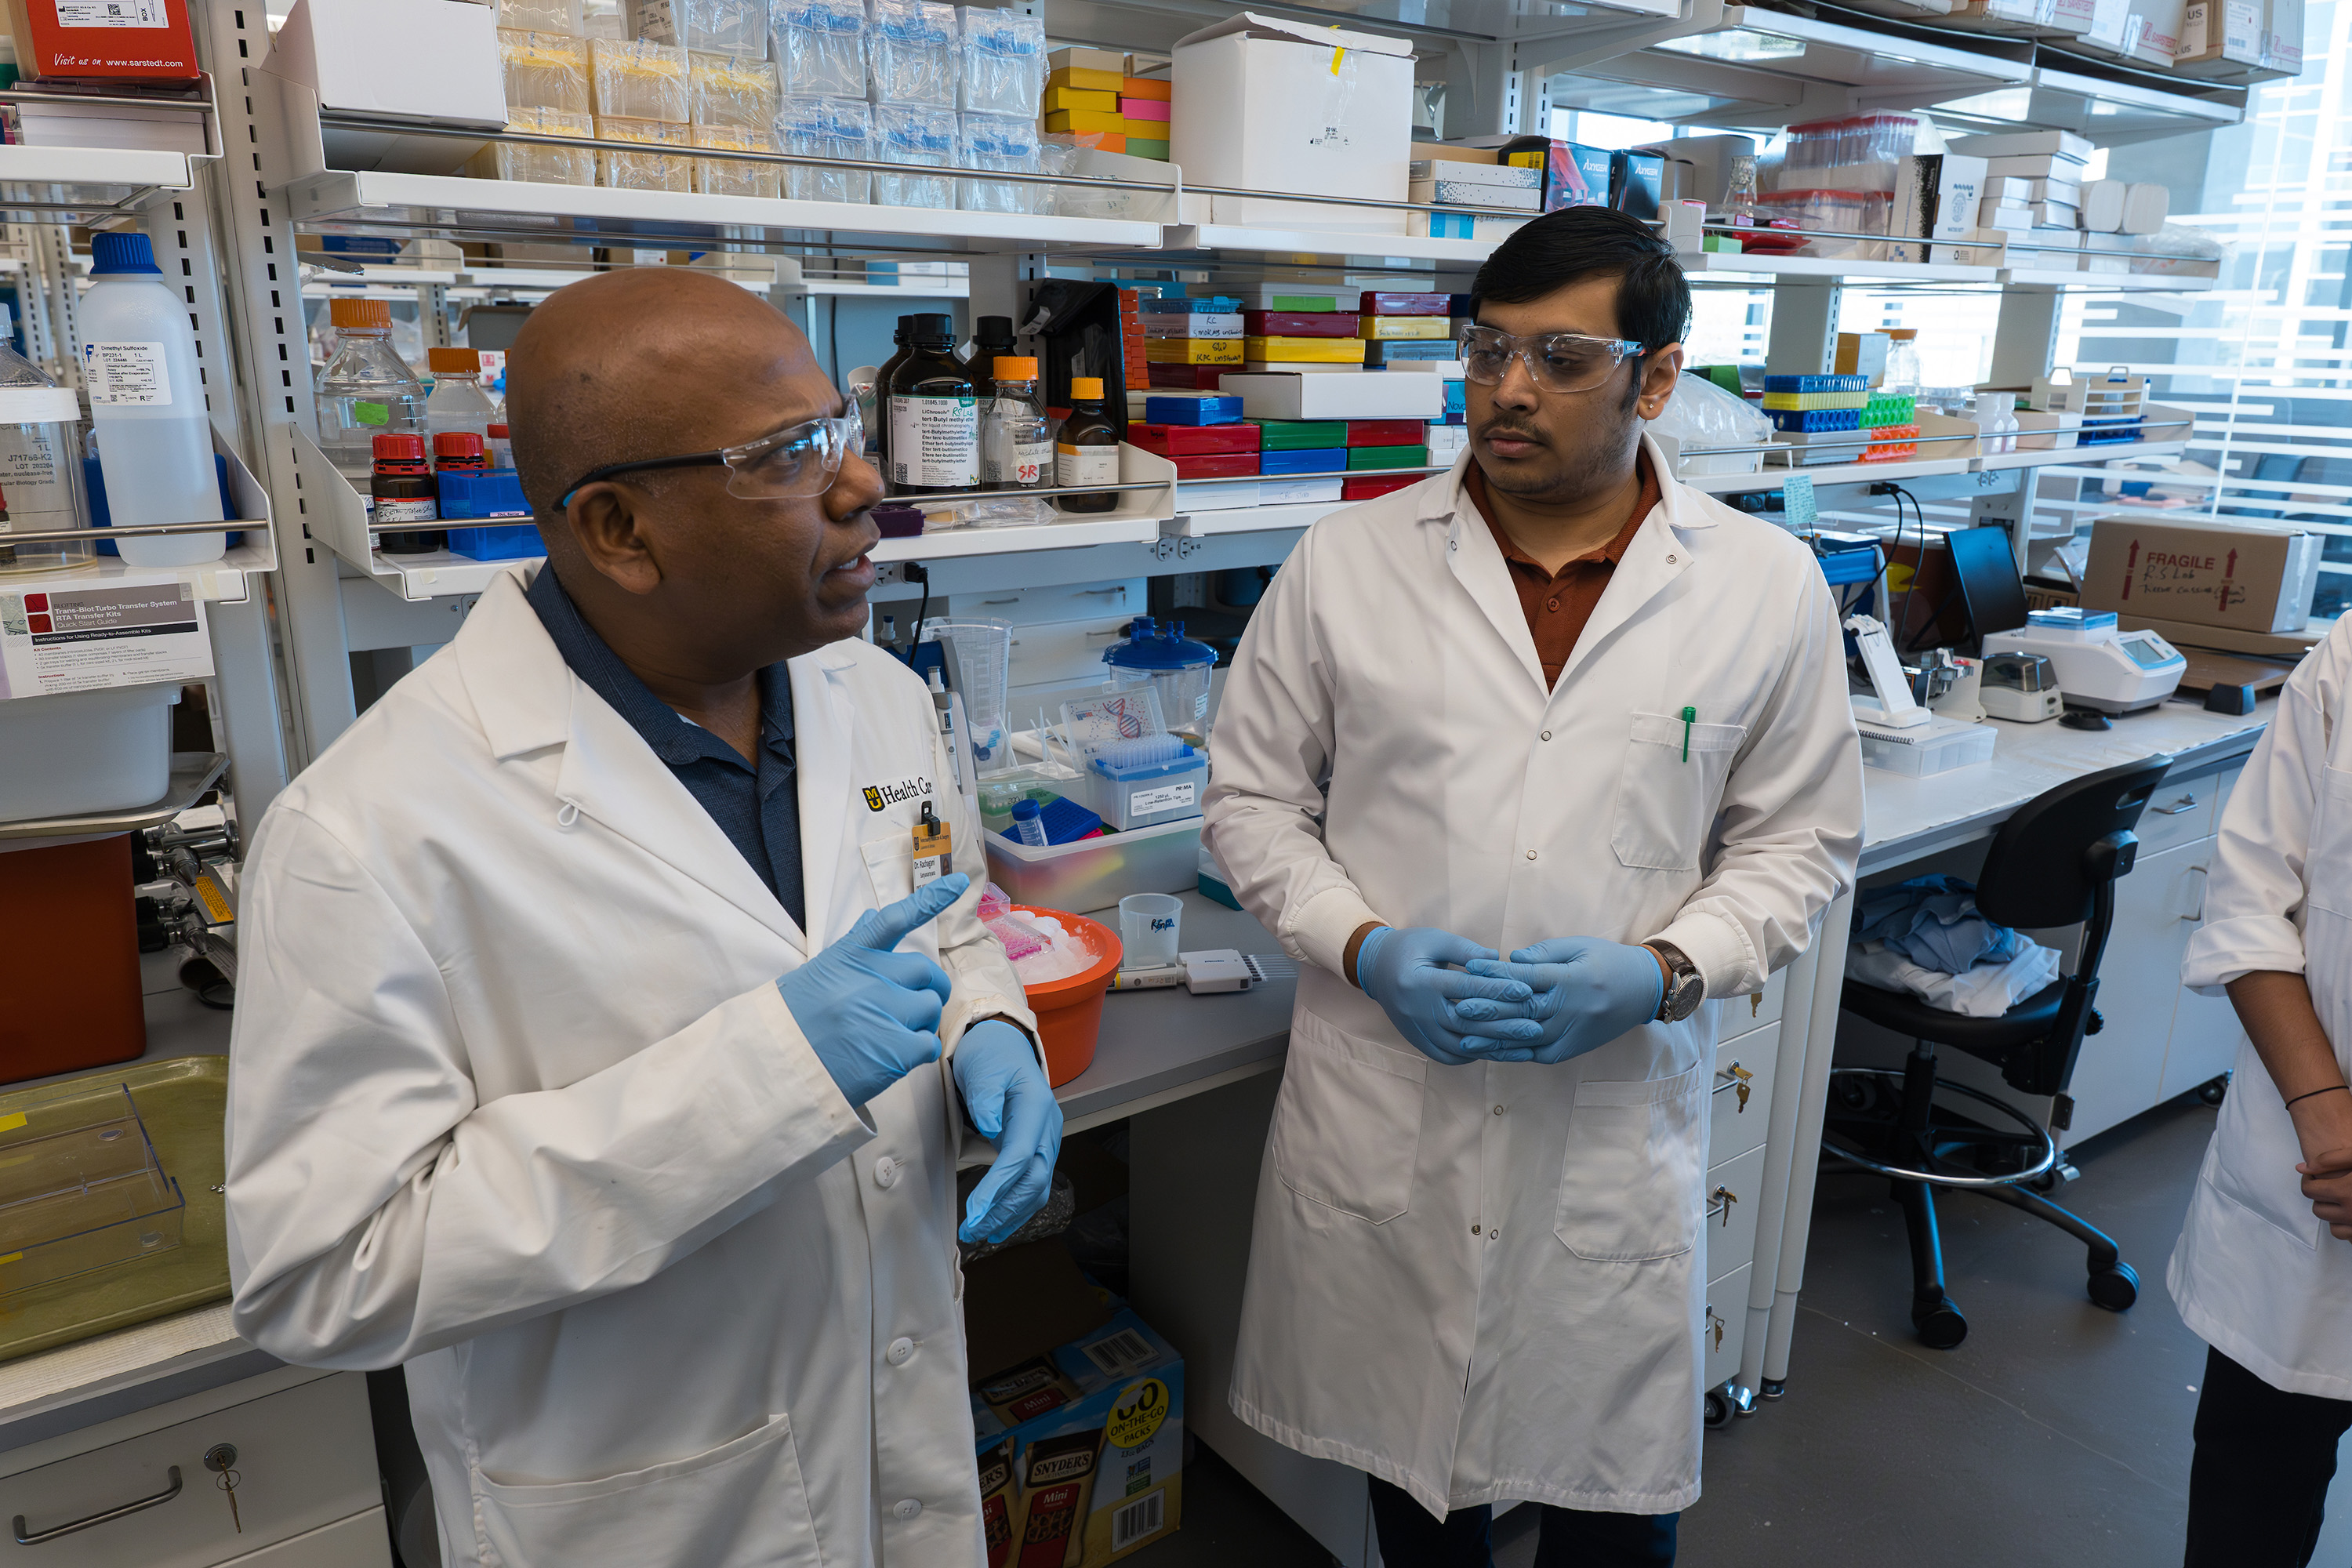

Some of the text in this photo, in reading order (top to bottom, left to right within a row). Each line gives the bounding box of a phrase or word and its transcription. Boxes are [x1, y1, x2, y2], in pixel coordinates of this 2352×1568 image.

[2187, 9, 2203, 20] US
[54, 53, 76, 67] Visit
[78, 57, 89, 66] us
[105, 59, 183, 67] www.sarstedt.com
[1582, 158, 1608, 172] AXYGEN
[1635, 163, 1658, 176] AXYGEN
[1196, 354, 1211, 362] KPC
[952, 406, 963, 417] RS
[963, 408, 974, 417] Lab
[1018, 464, 1038, 481] SR
[2146, 551, 2216, 571] FRAGILE
[90, 629, 140, 638] Ready-to-Assemble
[880, 779, 920, 805] Health
[1145, 797, 1173, 805] Low-Retention
[1023, 1394, 1051, 1410] Mini
[1110, 1405, 1165, 1436] ON-THE-GO
[1123, 1425, 1152, 1444] PACKS
[1033, 1453, 1091, 1477] SNYDER'S
[979, 1466, 1004, 1489] ER'S
[1043, 1488, 1069, 1504] Mini
[982, 1504, 993, 1517] ni
